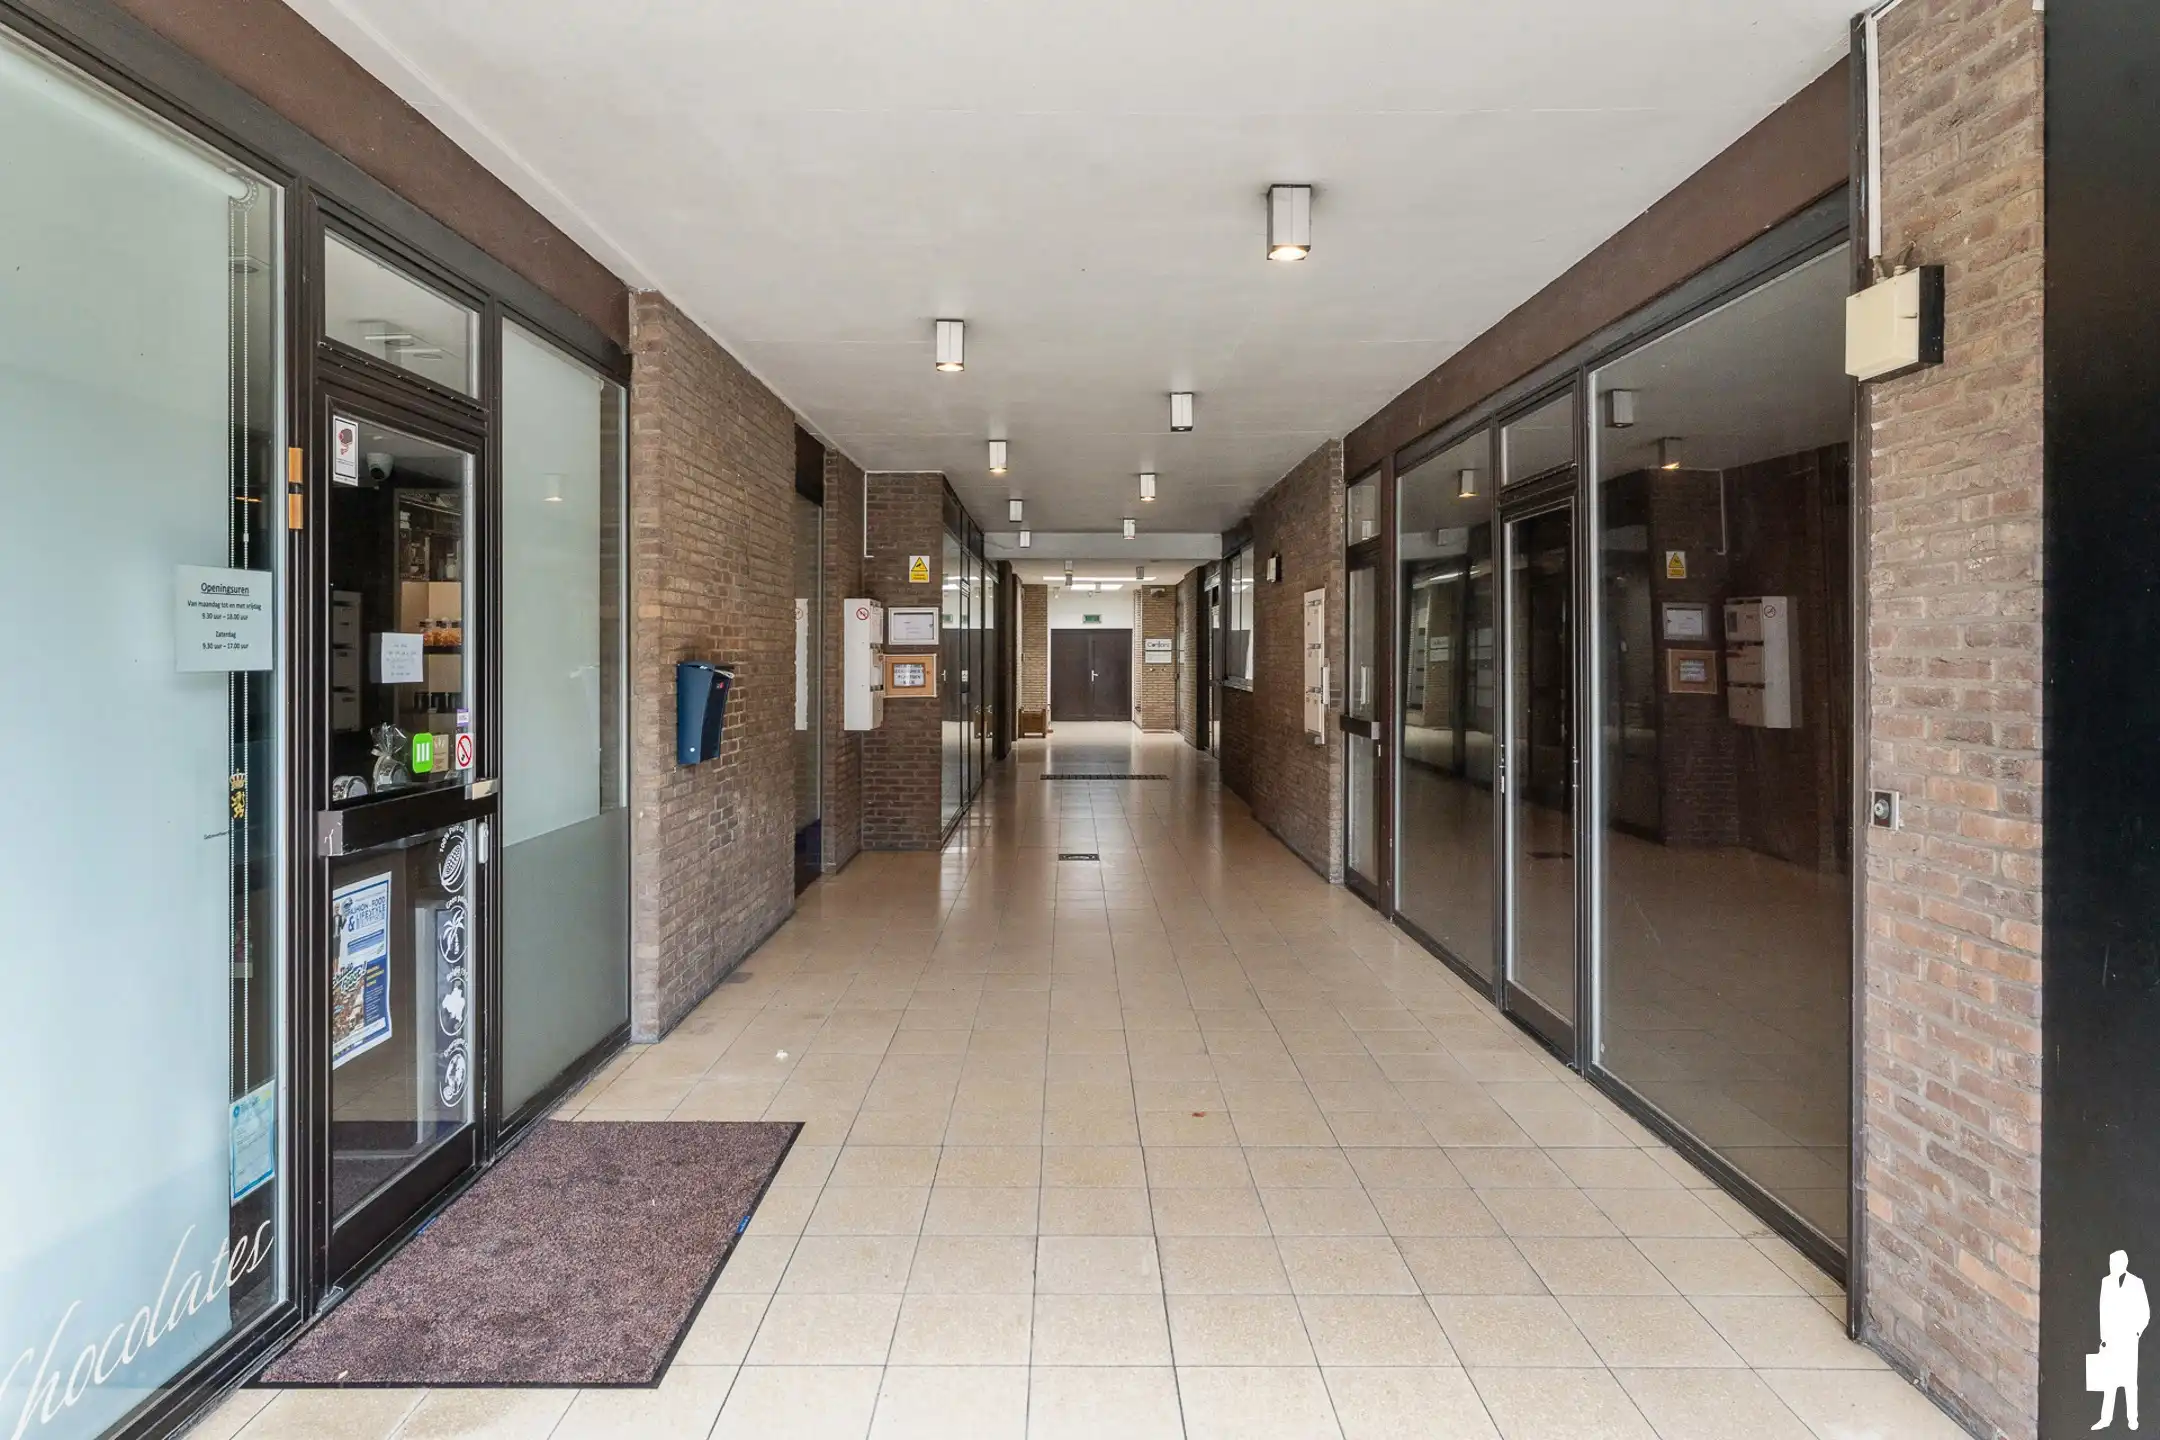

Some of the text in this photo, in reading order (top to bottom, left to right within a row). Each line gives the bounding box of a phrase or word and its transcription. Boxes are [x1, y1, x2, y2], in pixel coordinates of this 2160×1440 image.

[201, 582, 249, 596] Openingsuren
[198, 601, 220, 609] maandag
[246, 602, 262, 611] vrijdag
[215, 631, 236, 639] Zaterdag
[202, 642, 213, 650] 9.30
[227, 642, 240, 650] 17.00
[348, 915, 355, 932] &
